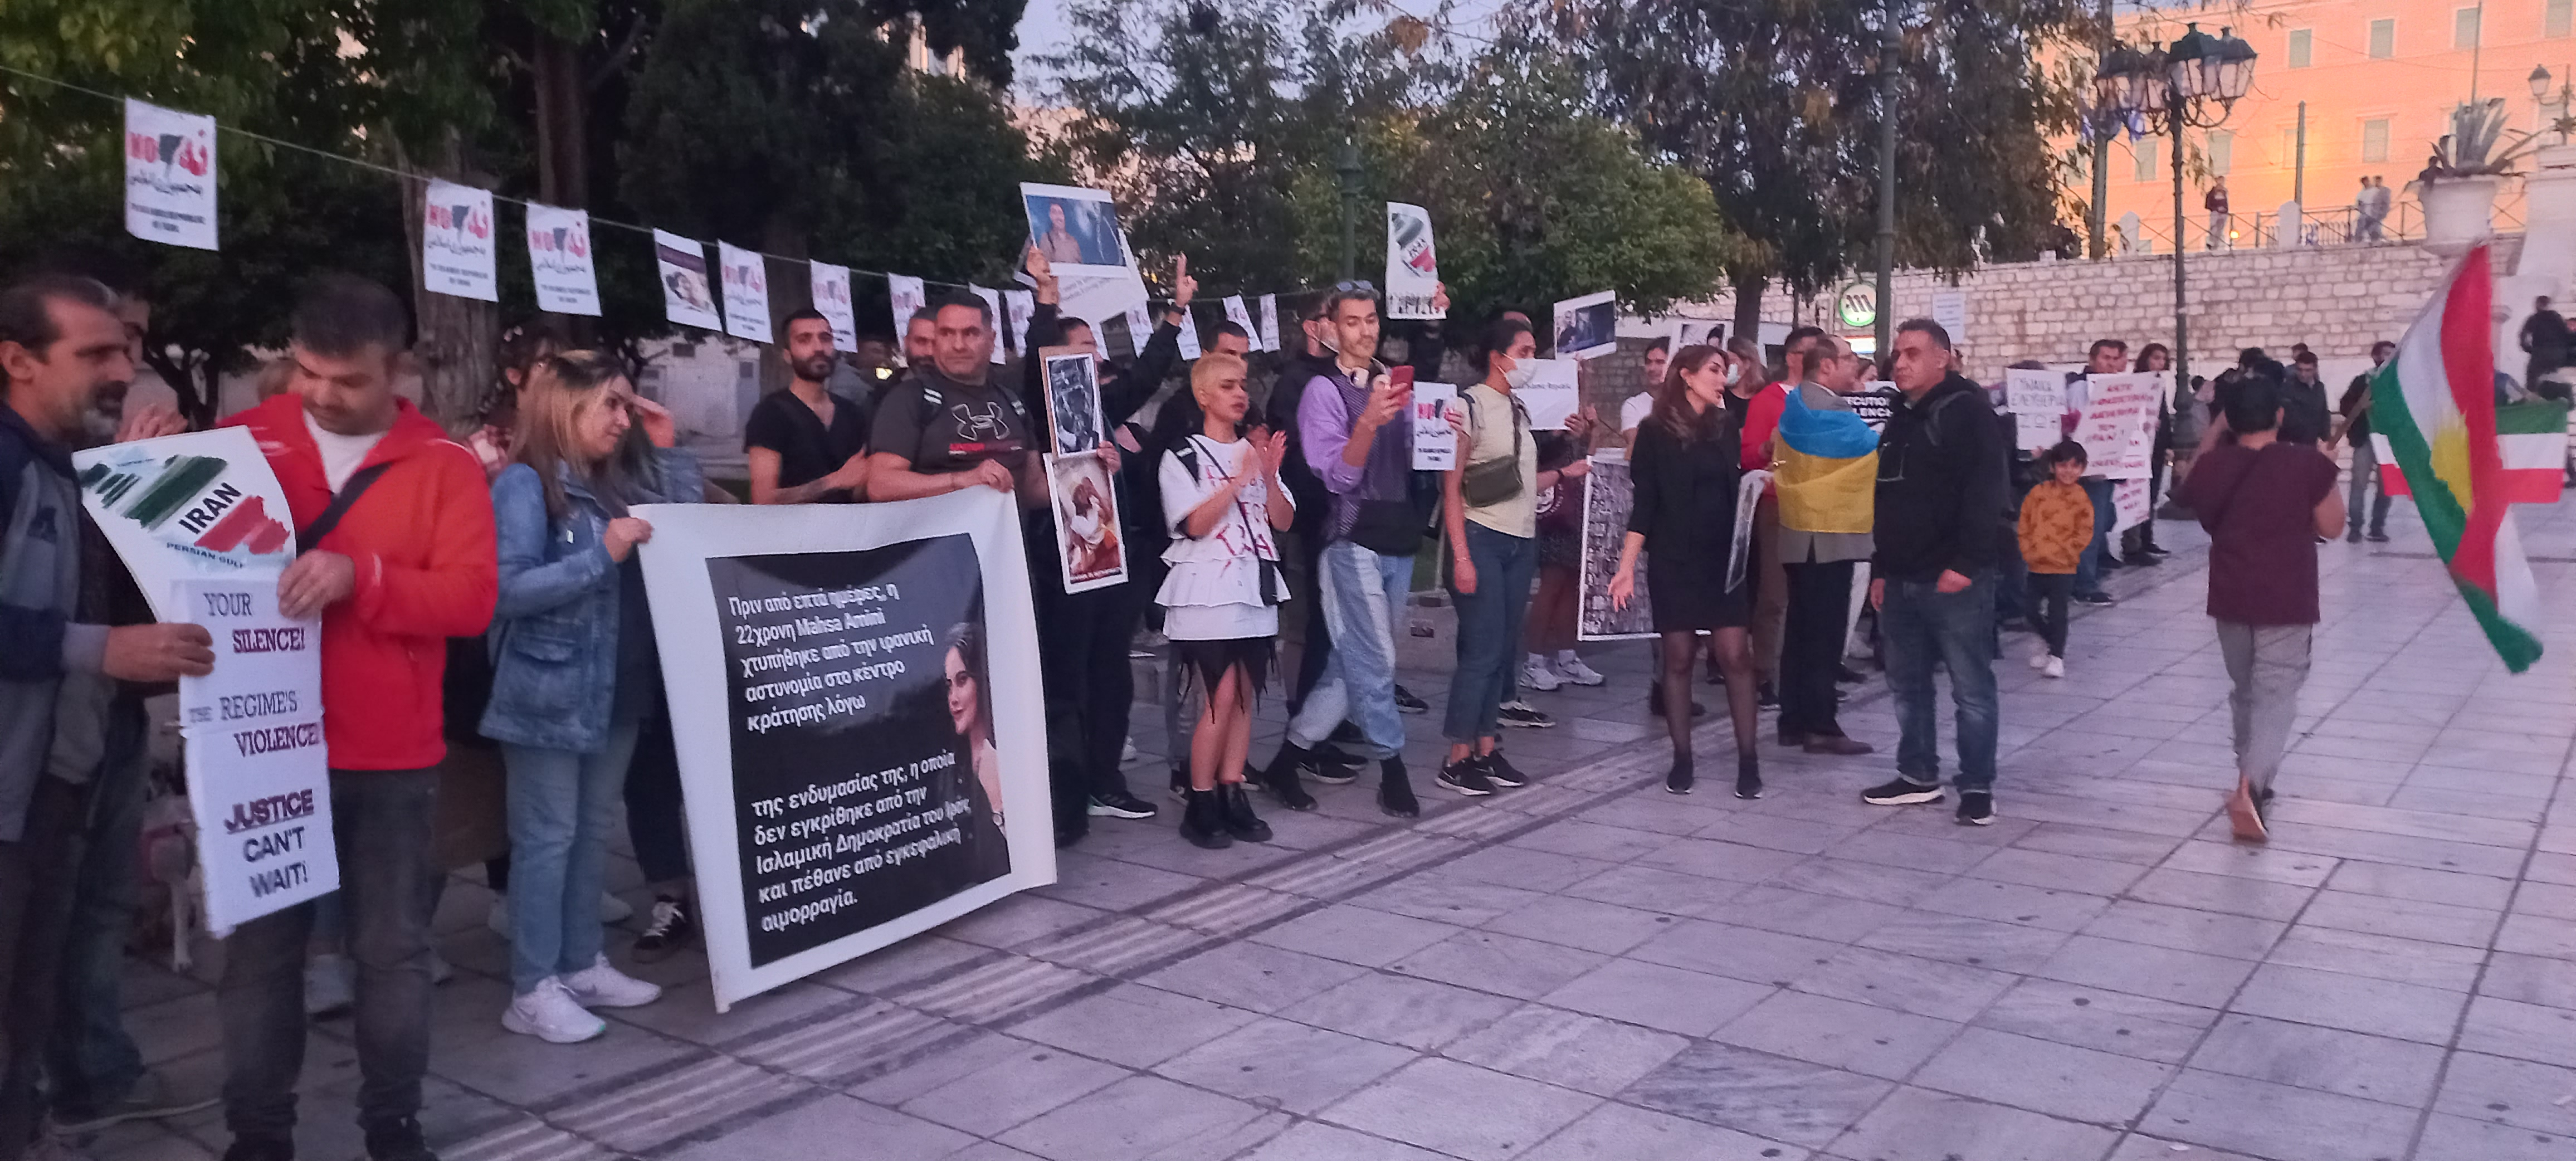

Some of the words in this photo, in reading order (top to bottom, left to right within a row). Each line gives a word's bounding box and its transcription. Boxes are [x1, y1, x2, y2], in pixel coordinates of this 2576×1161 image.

[178, 482, 242, 535] IRAN
[167, 542, 216, 560] PERSIAN
[218, 555, 247, 569] GULF
[203, 592, 252, 616] YOUR
[728, 596, 762, 620] Πριν
[764, 591, 792, 613] από
[793, 587, 829, 609] επτά
[885, 583, 900, 601] η
[232, 627, 305, 653] SILENCE!
[735, 623, 797, 647] 22χρονη
[795, 615, 843, 638] Mahsa
[740, 647, 821, 679] χτυπήθηκε
[821, 638, 851, 661] από
[851, 637, 877, 658] την
[878, 624, 935, 653] ιρανική
[745, 671, 823, 703] αστυνομία
[824, 670, 852, 688] στο
[852, 660, 906, 680] κέντρο
[219, 690, 297, 721] REGIME'S
[747, 704, 827, 734] κράτησης
[826, 694, 867, 716] λόγω
[751, 797, 784, 818] της
[788, 772, 879, 809] ενδυμασίας
[880, 765, 909, 787] της,
[910, 761, 920, 780] η
[920, 748, 957, 774] οποία
[224, 788, 314, 832] JUSTICE
[754, 825, 786, 846] δεν
[791, 802, 874, 838] εγκρίθηκε
[876, 788, 904, 813] από
[904, 786, 928, 807] την
[243, 826, 305, 862] CAN'T
[755, 836, 832, 875] Ισλαμική
[836, 812, 921, 853] Δημοκρατία
[922, 807, 944, 825] του
[249, 860, 308, 897] WAIT!
[758, 882, 788, 904] και
[791, 863, 852, 894] πέθανε
[853, 848, 884, 875] από
[761, 887, 858, 933] αιμορραγία.
